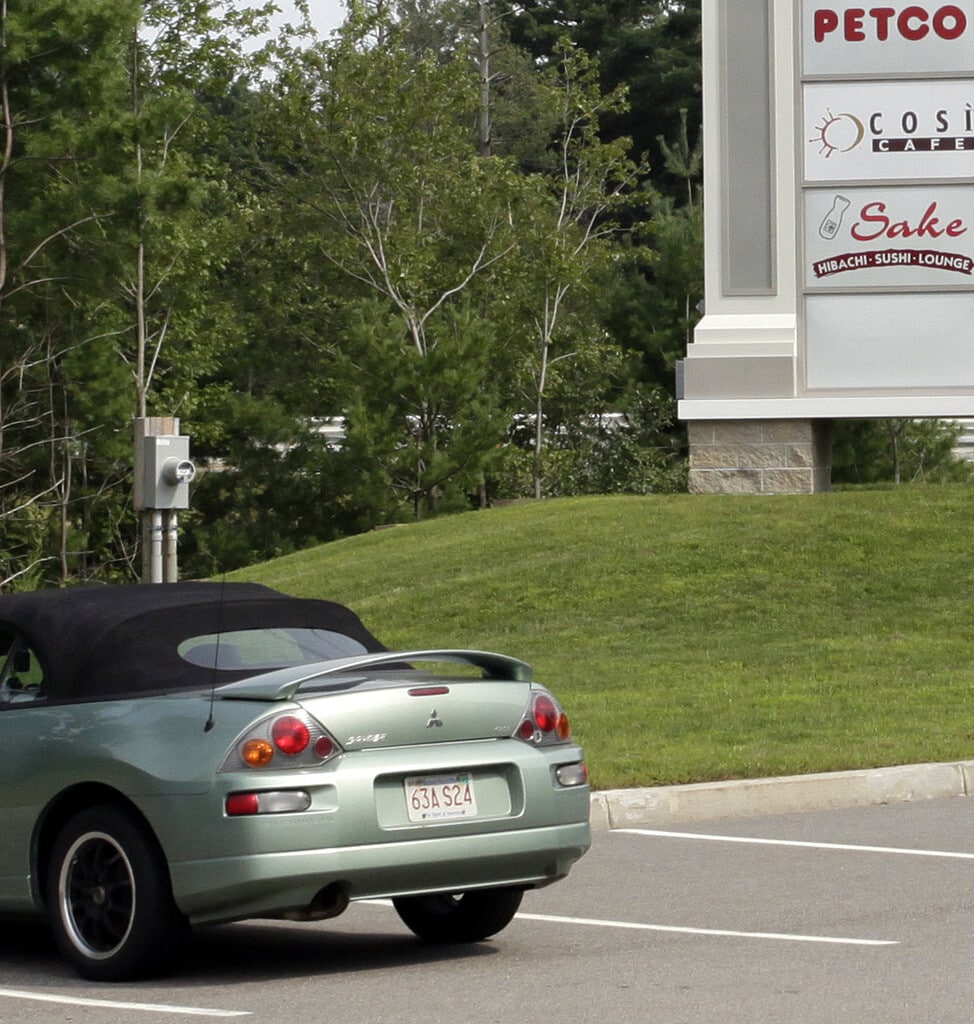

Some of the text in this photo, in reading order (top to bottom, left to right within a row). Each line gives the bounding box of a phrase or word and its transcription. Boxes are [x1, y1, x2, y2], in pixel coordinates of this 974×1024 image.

[813, 5, 967, 43] PETCO
[878, 137, 966, 152] CAFE
[850, 201, 968, 242] Sake
[817, 252, 971, 274] HIBACHI SUSHI LOUNGE
[411, 784, 473, 810] 63A S24
